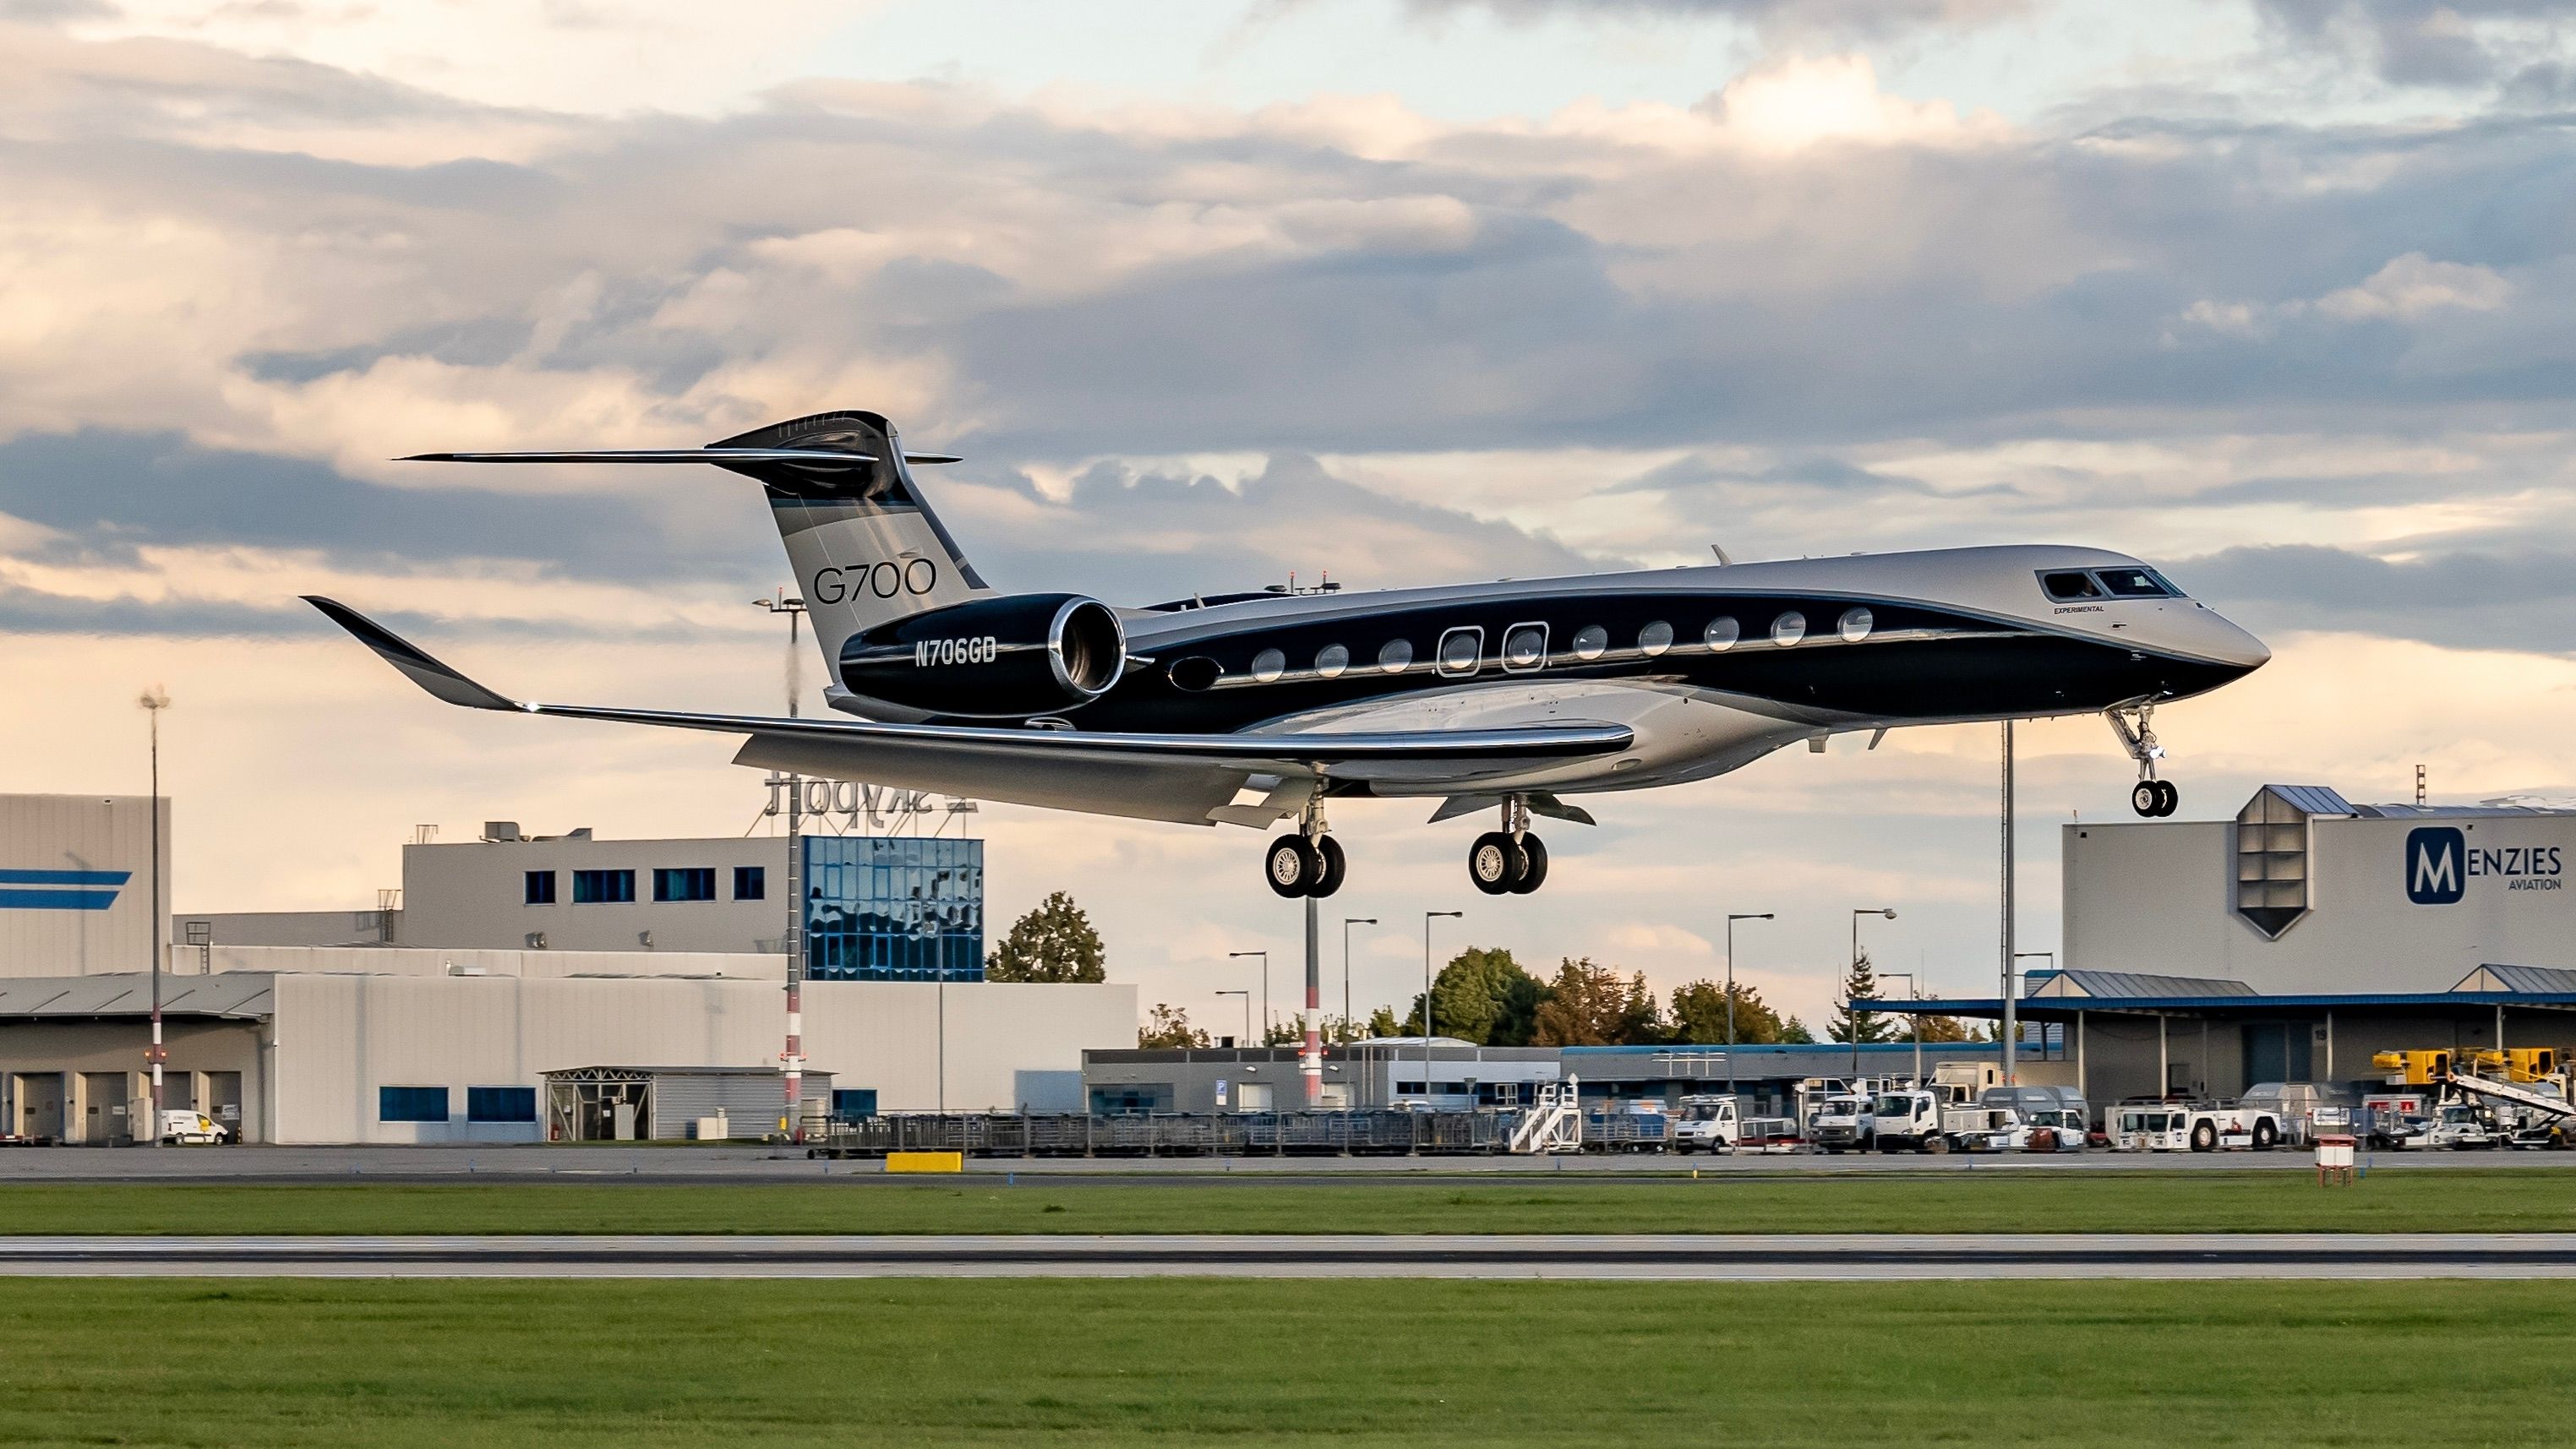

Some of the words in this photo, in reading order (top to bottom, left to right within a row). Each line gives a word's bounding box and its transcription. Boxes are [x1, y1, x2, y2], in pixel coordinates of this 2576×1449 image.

[814, 558, 936, 605] G700
[2054, 606, 2104, 615] EXPERIMENTAL
[915, 636, 996, 667] N706GD
[2414, 842, 2562, 893] MENZIES
[2508, 879, 2562, 891] AVIATION
[1218, 1082, 1225, 1092] P
